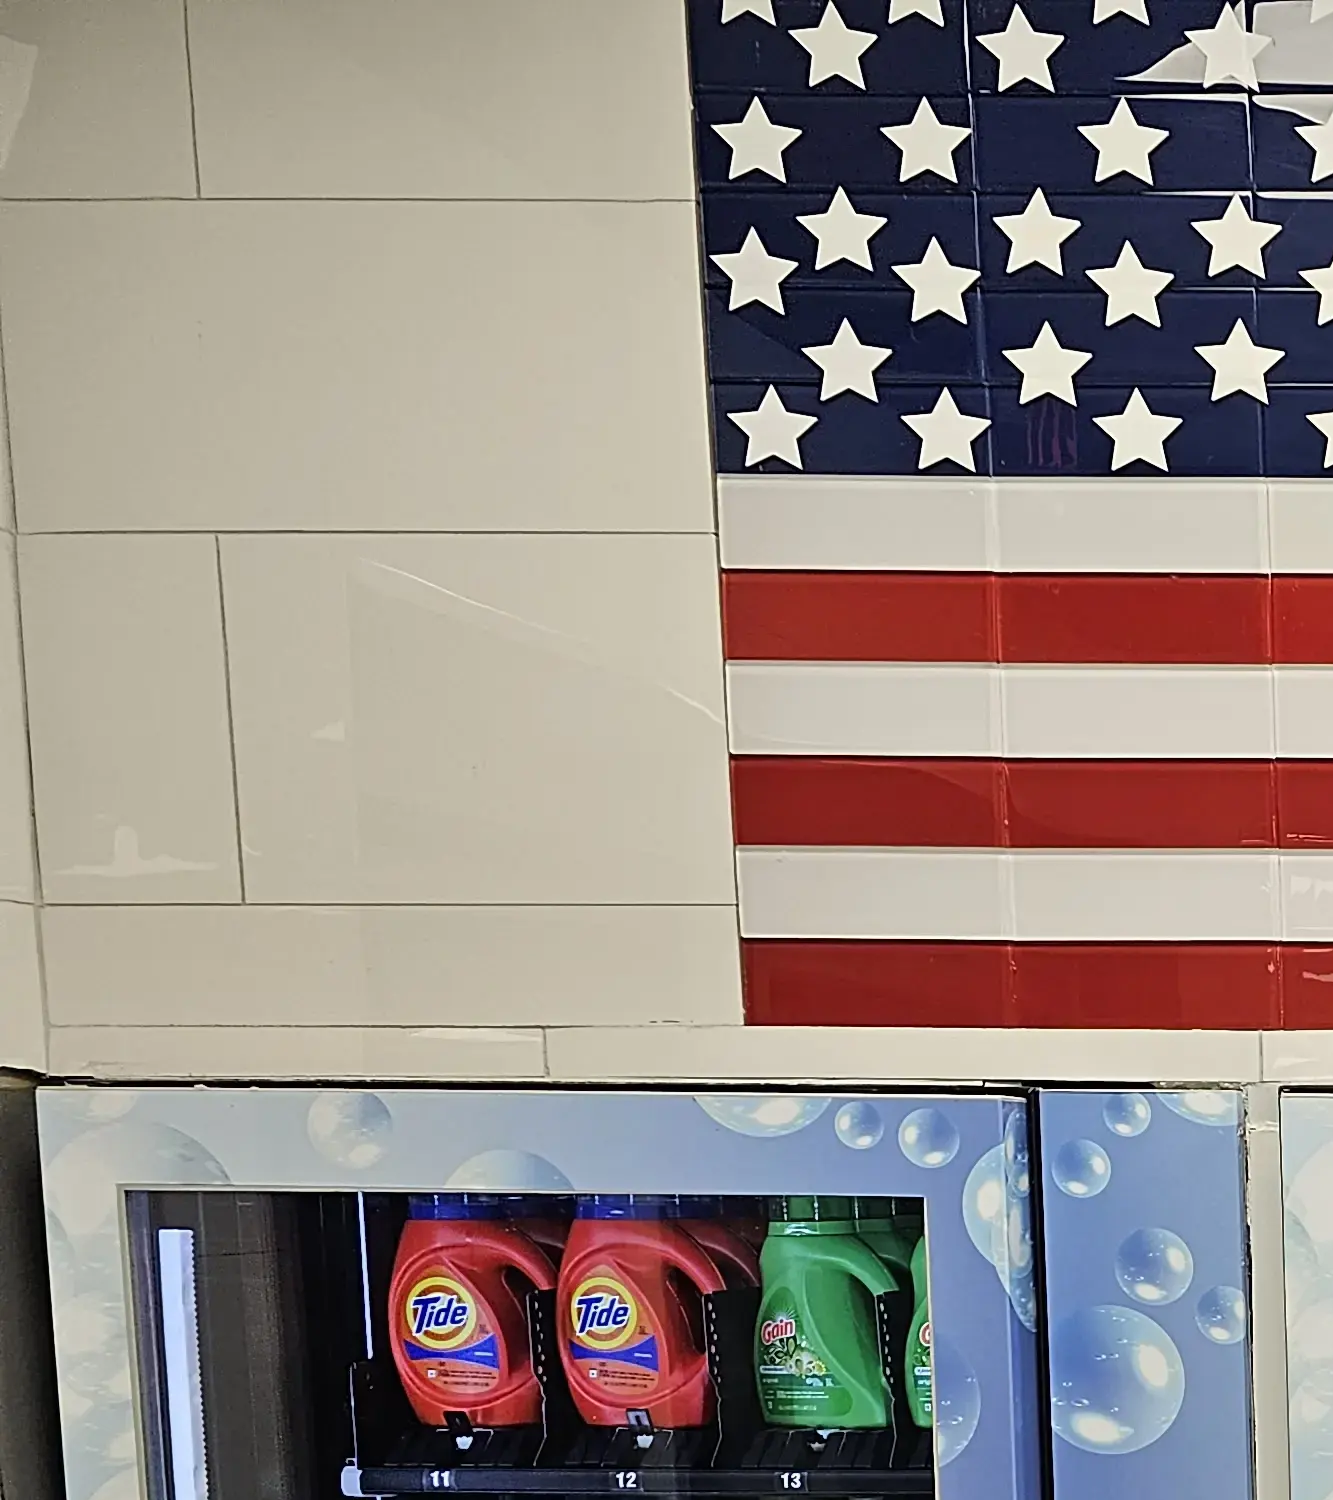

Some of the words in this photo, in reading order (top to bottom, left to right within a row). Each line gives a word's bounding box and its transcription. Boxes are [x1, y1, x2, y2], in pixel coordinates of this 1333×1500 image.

[411, 1291, 469, 1335] Tide
[576, 1291, 629, 1334] Tide
[760, 1317, 796, 1344] Gain
[429, 1470, 450, 1488] 11
[615, 1471, 637, 1488] 12
[780, 1472, 802, 1489] 13
